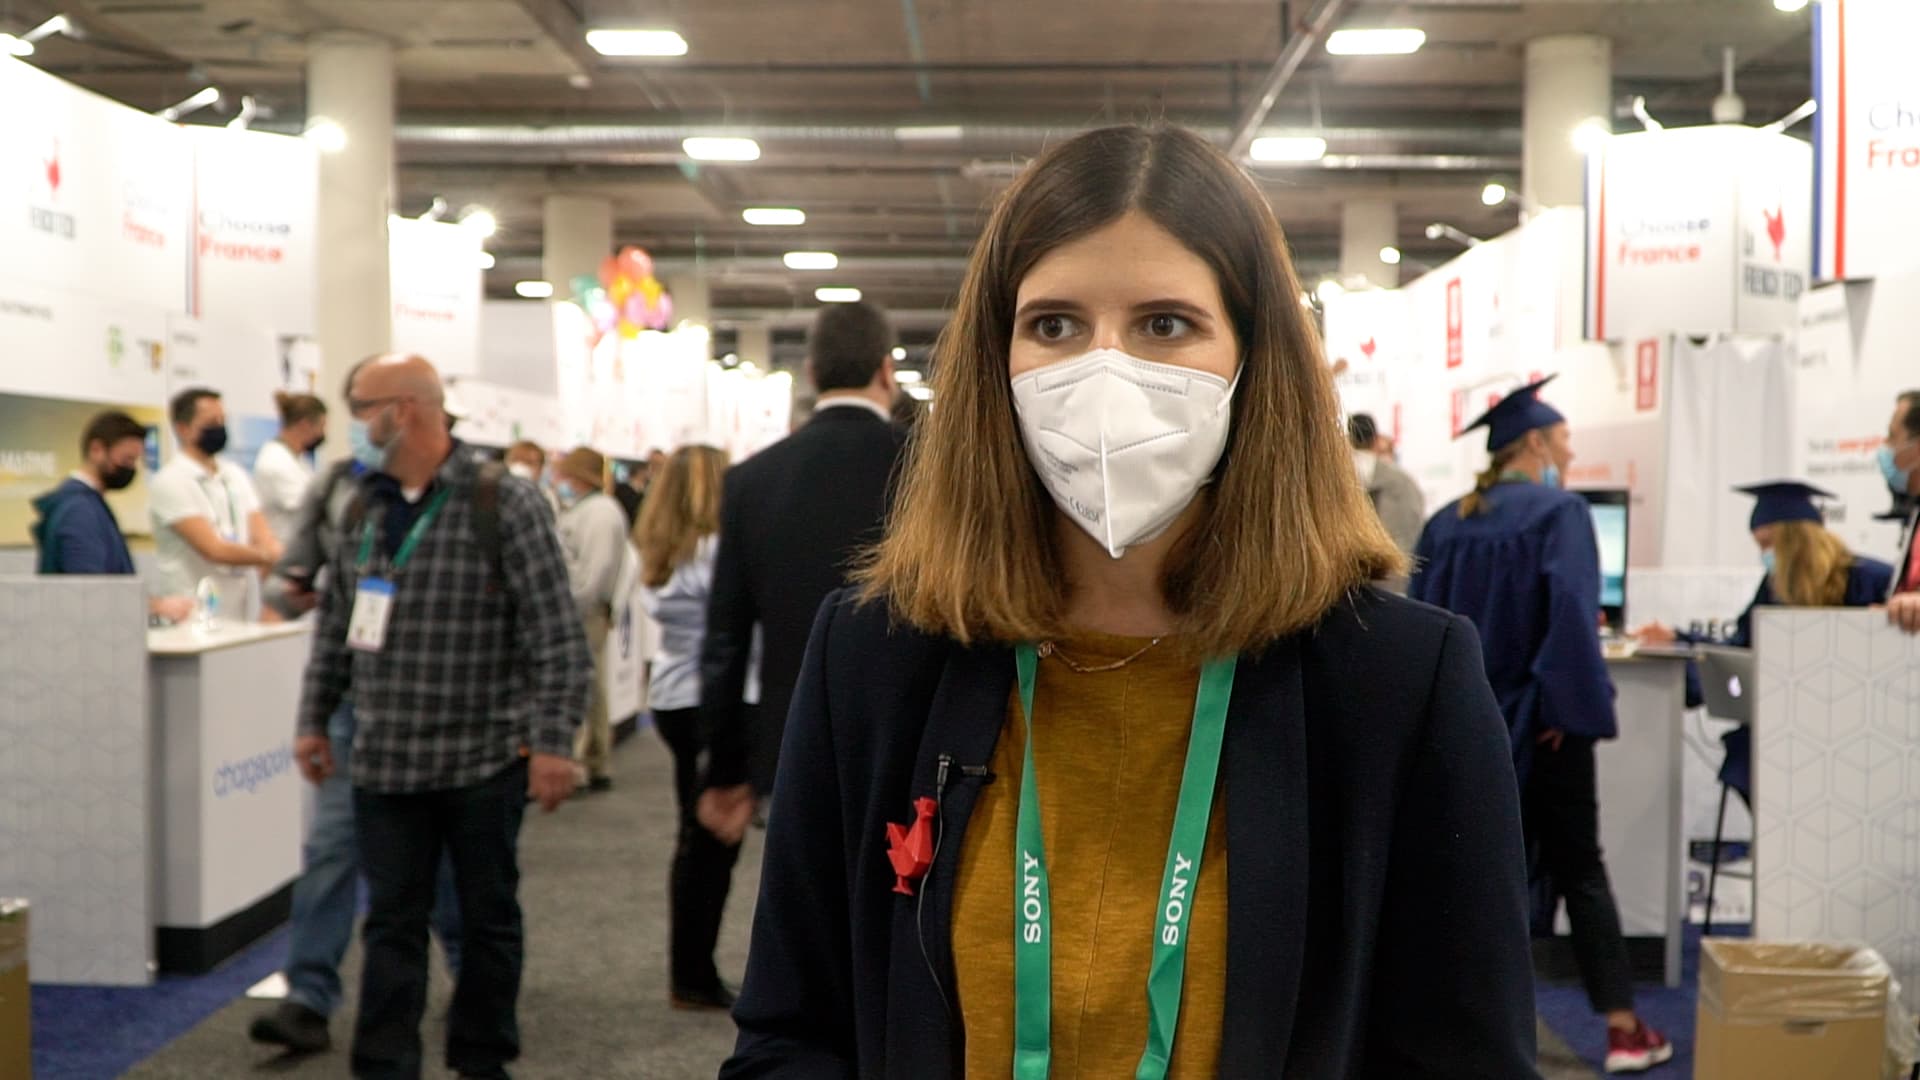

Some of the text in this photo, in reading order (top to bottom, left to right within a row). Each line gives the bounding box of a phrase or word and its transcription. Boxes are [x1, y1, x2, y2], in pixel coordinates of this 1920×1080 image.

[1868, 99, 1920, 132] Ch
[1620, 215, 1711, 240] Choose
[199, 233, 284, 264] France
[1618, 240, 1702, 266] France
[1024, 850, 1041, 944] SONY
[1162, 852, 1192, 945] SONY
